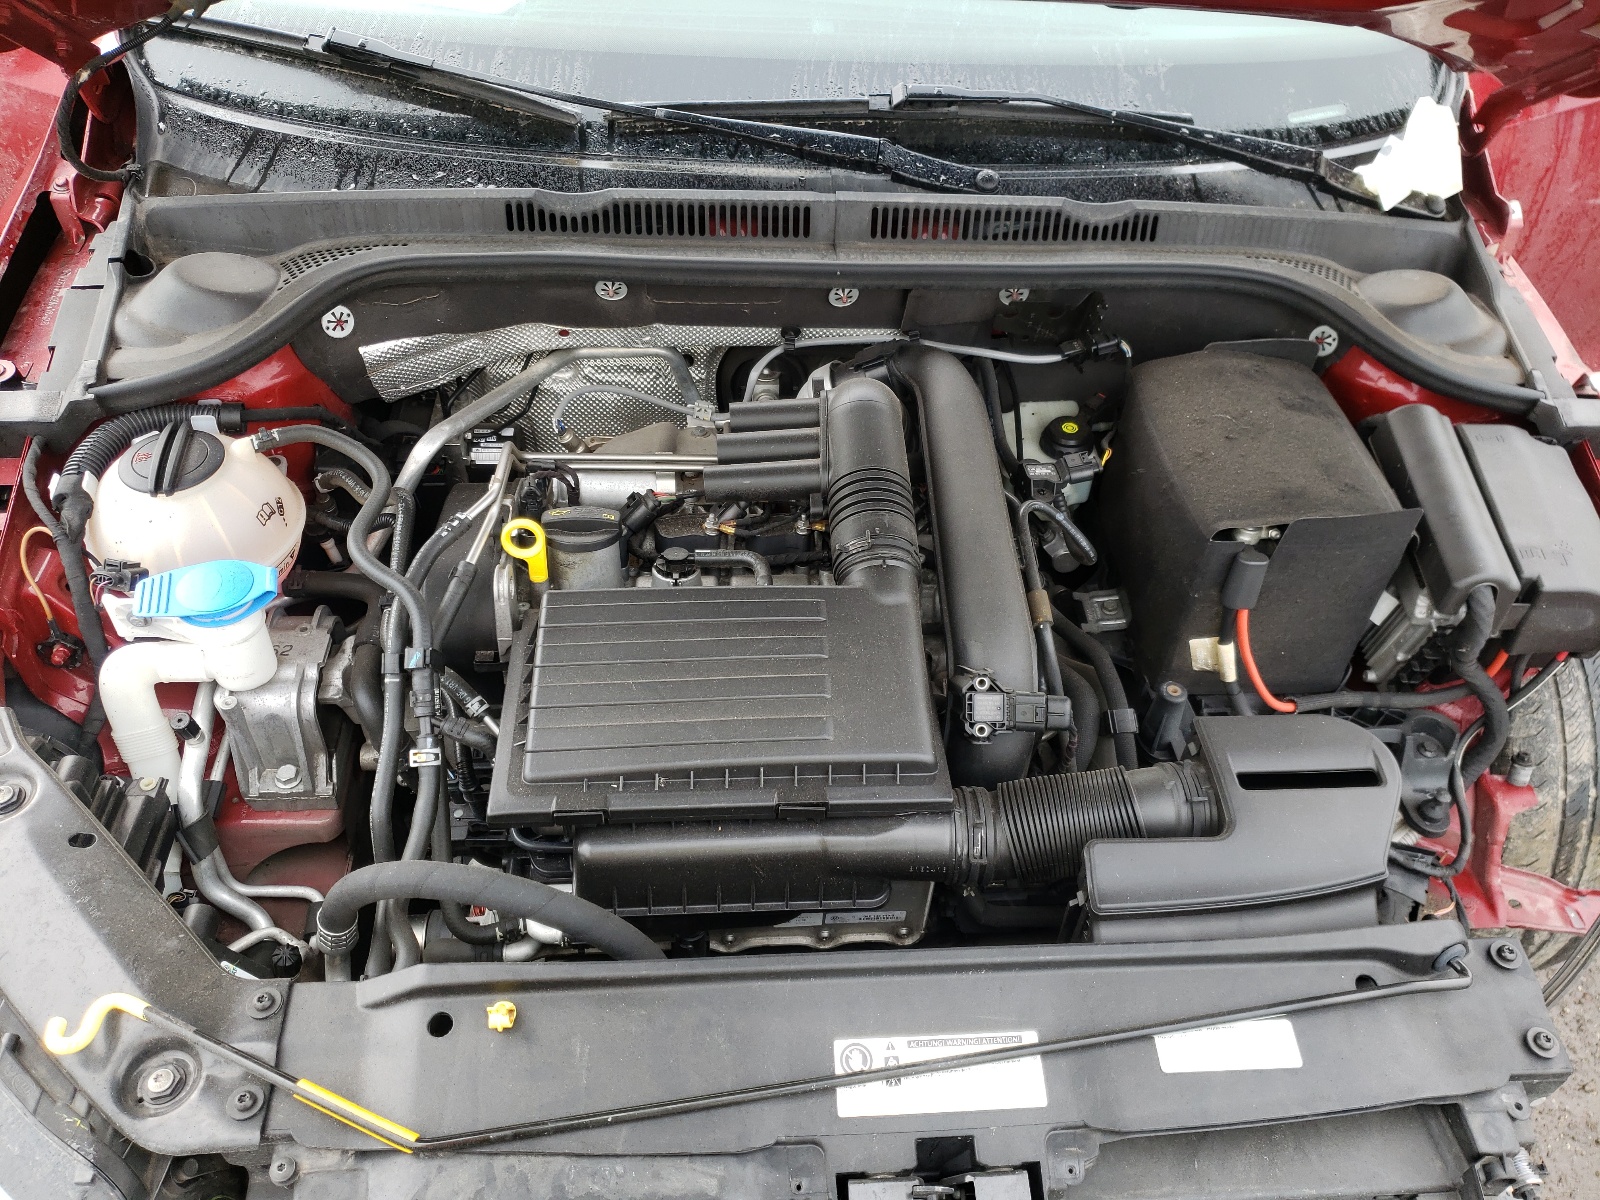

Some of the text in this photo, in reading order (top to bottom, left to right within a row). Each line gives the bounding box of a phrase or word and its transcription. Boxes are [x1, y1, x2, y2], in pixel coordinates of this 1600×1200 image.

[909, 1035, 1020, 1048] ACHTUNG! WARNING! ATTENTION!
